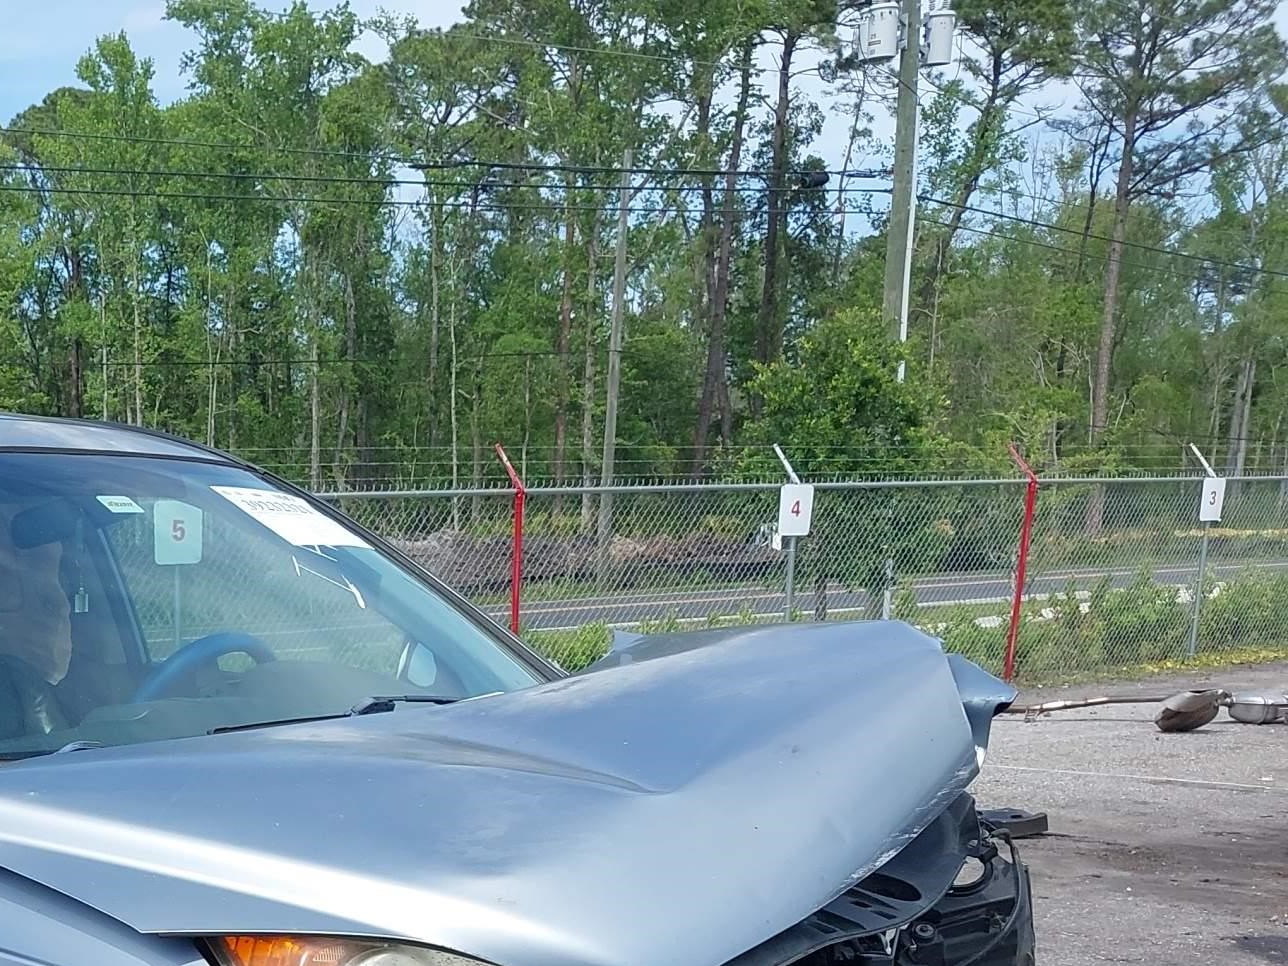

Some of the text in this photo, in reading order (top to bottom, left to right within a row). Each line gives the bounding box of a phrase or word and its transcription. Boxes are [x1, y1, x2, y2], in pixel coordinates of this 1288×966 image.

[1209, 490, 1217, 506] 3
[791, 500, 801, 517] 4
[172, 519, 186, 541] 5
